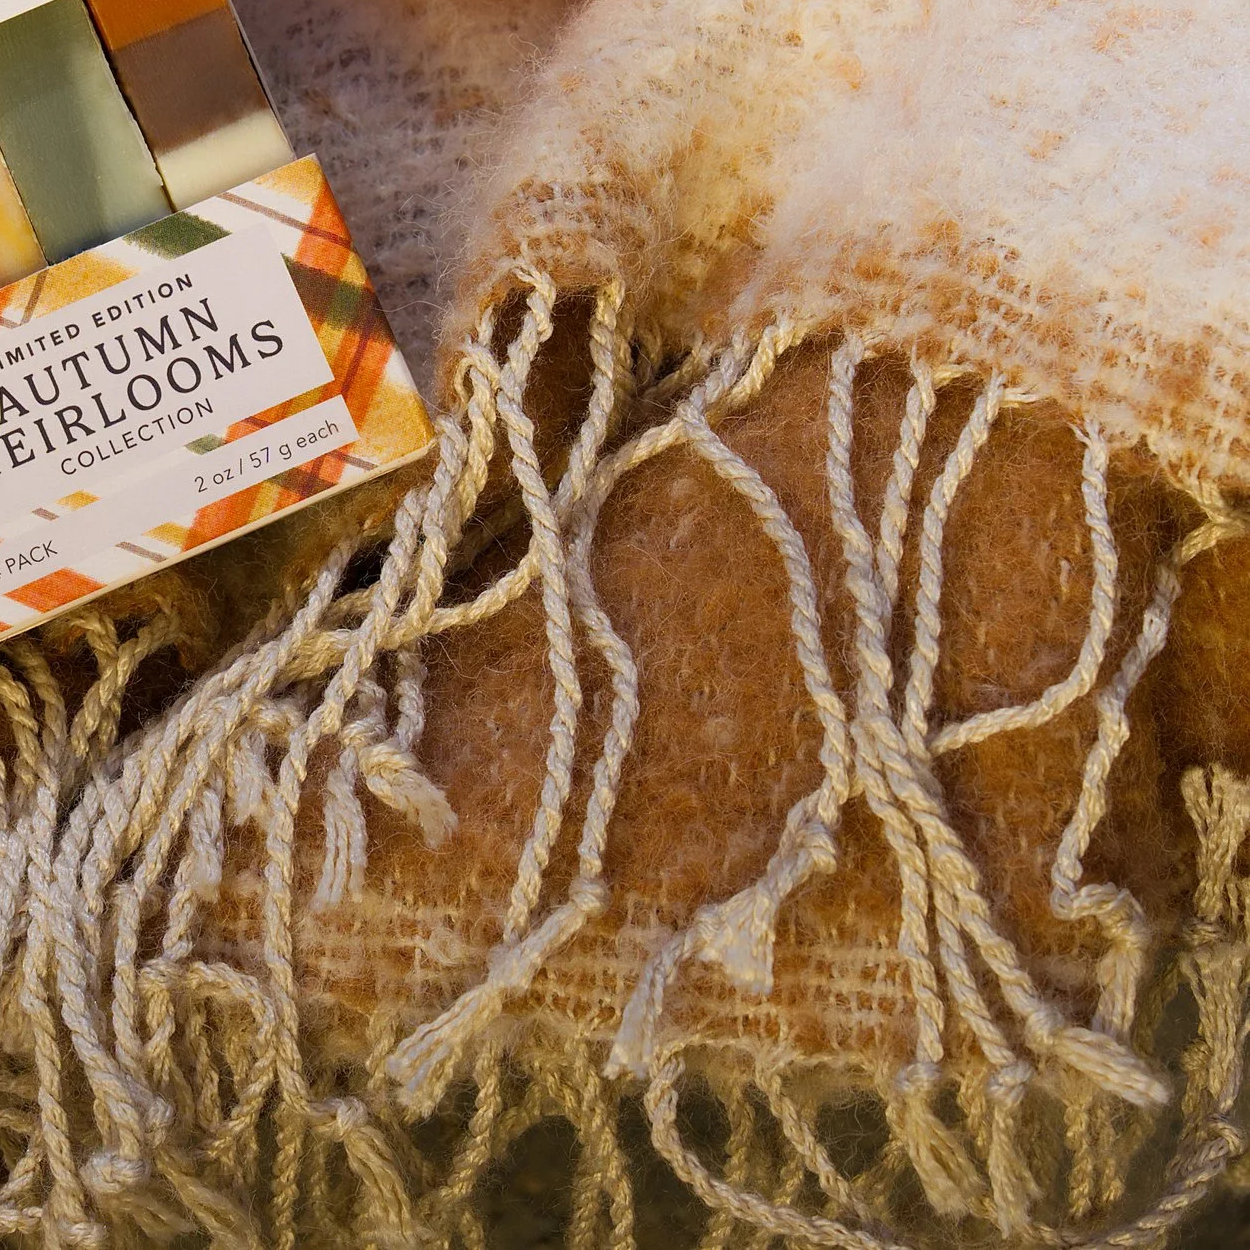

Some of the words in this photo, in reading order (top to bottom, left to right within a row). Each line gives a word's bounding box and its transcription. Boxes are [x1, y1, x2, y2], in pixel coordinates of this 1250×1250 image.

[91, 273, 193, 329] EDITION
[60, 397, 214, 476] COLLECTION
[193, 475, 209, 494] 2
[212, 468, 235, 485] oz
[248, 446, 270, 469] 57
[278, 443, 293, 461] g
[296, 419, 340, 449] each
[4, 539, 59, 575] PACK
